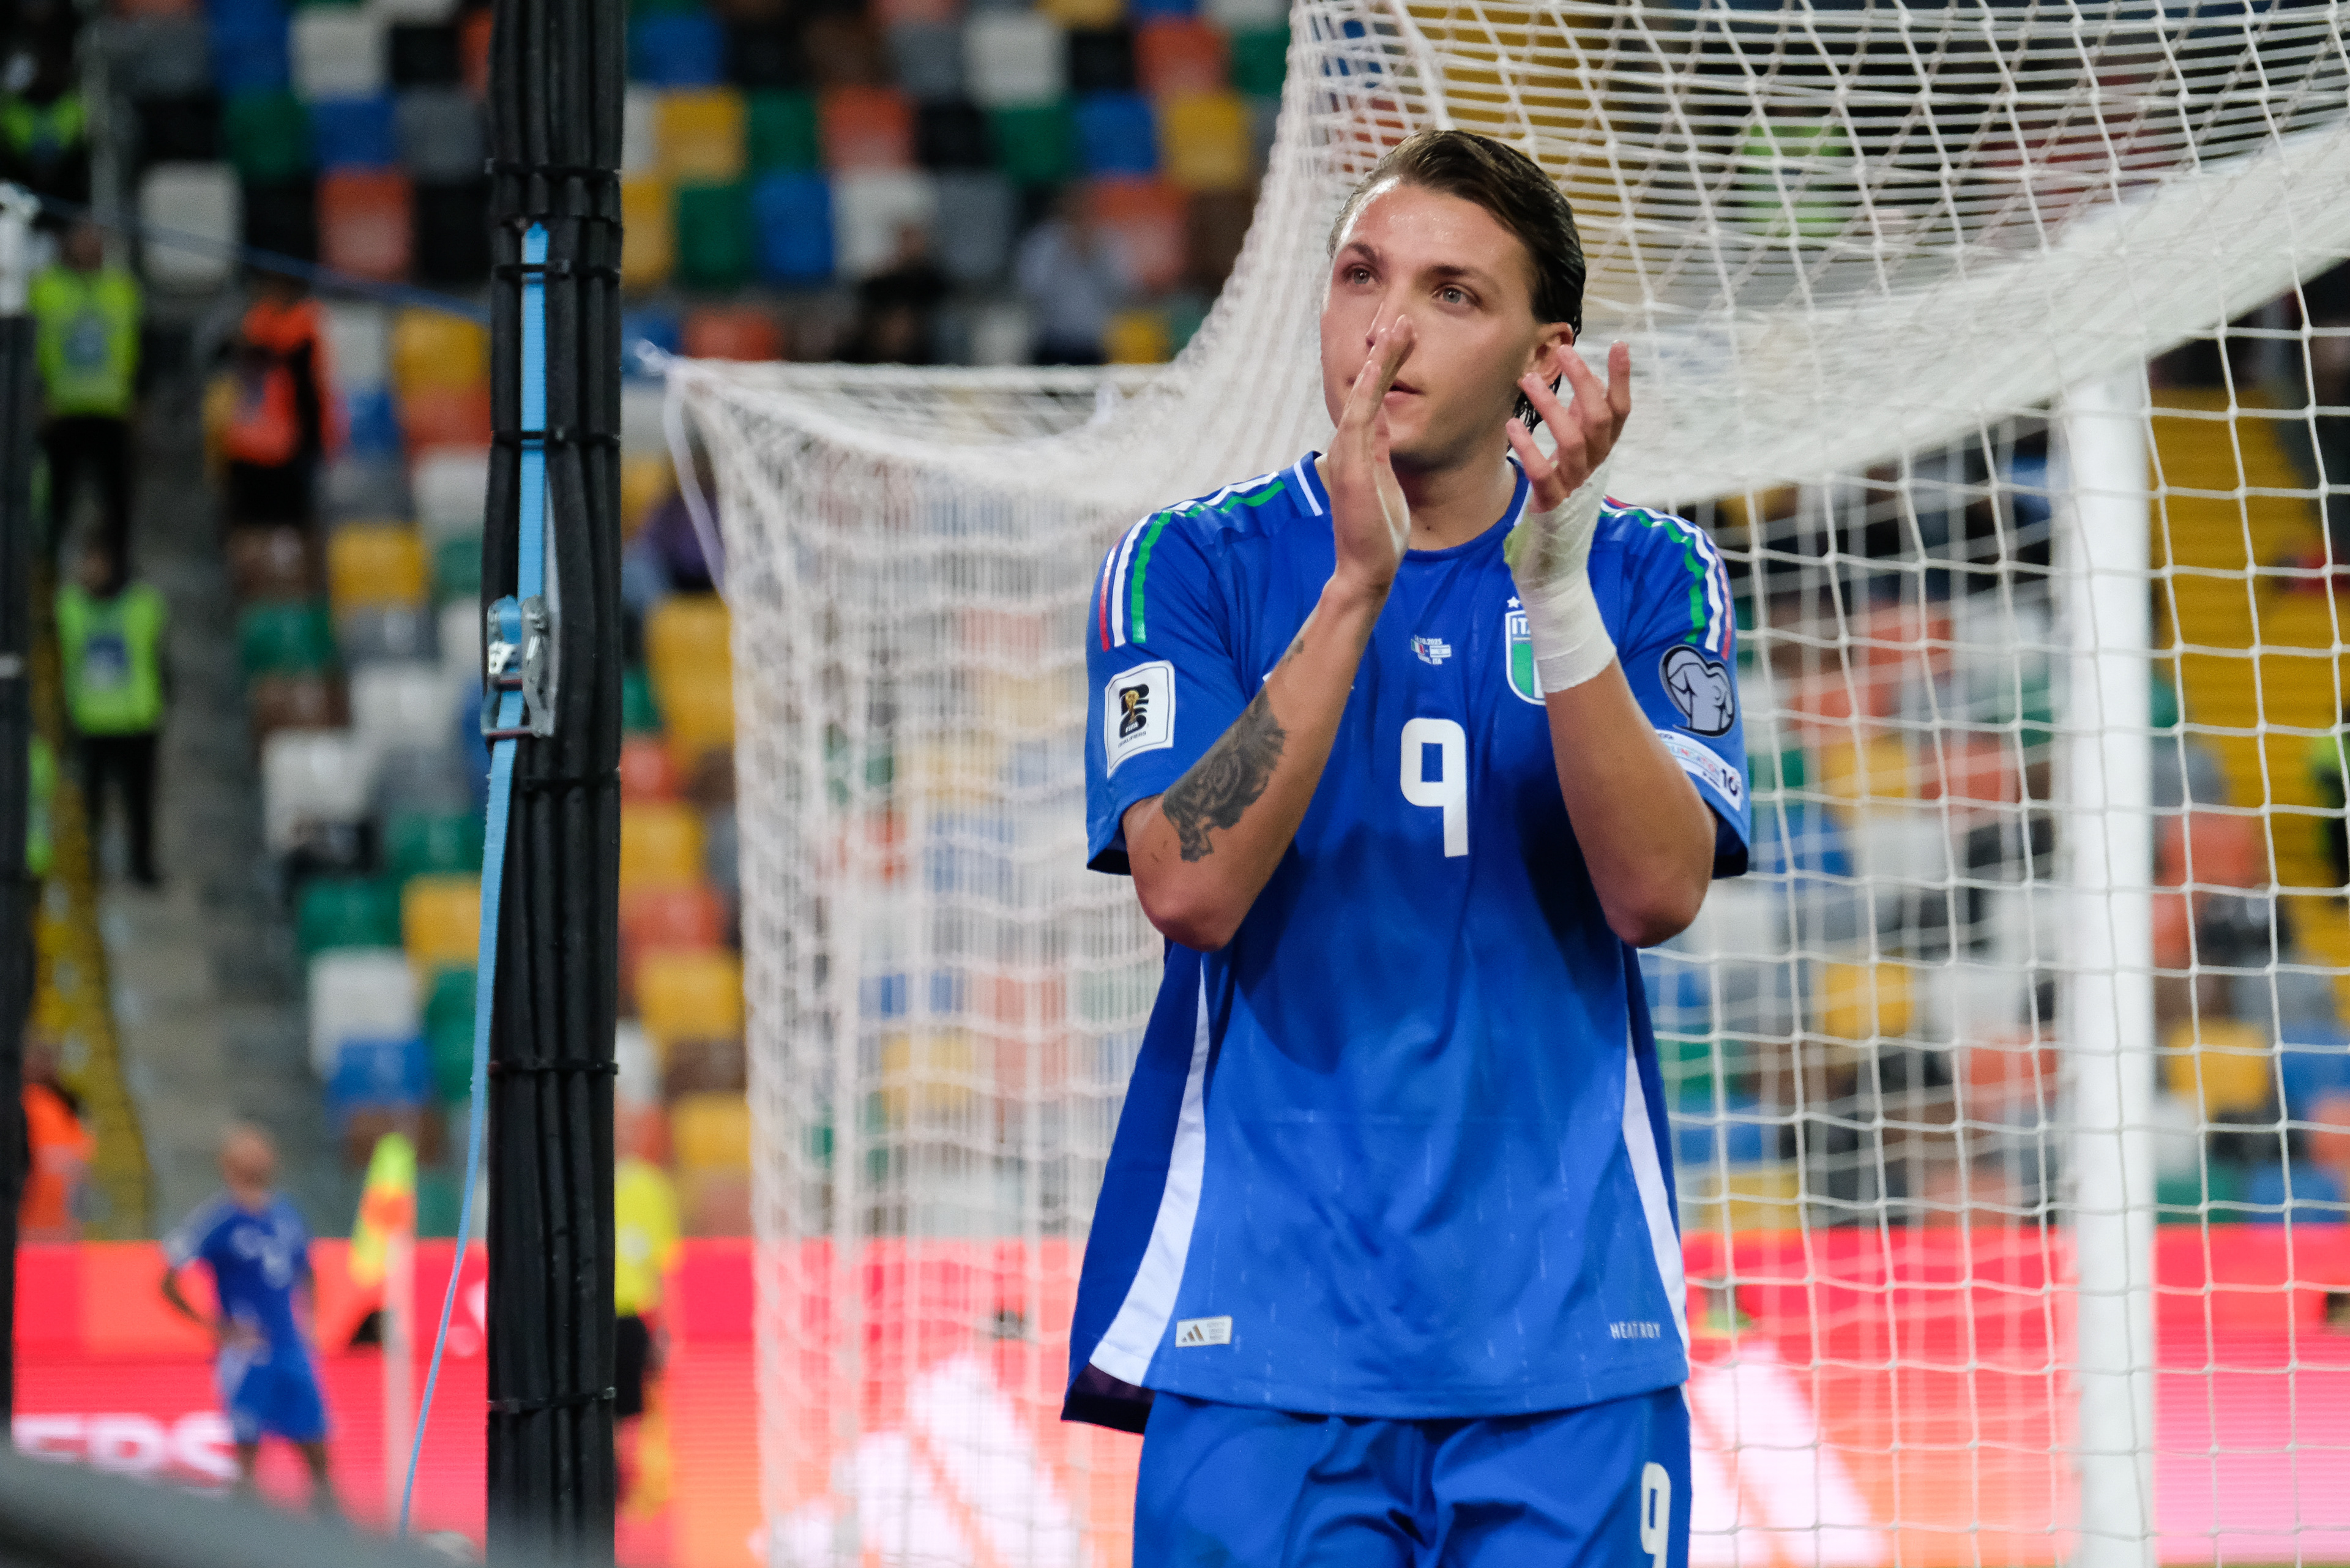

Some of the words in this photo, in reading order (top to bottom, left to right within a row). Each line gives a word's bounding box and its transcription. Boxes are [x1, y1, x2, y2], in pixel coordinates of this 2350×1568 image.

[1125, 722, 1139, 733] FIFA
[1400, 717, 1468, 857] 9
[1640, 1462, 1671, 1568] 9
